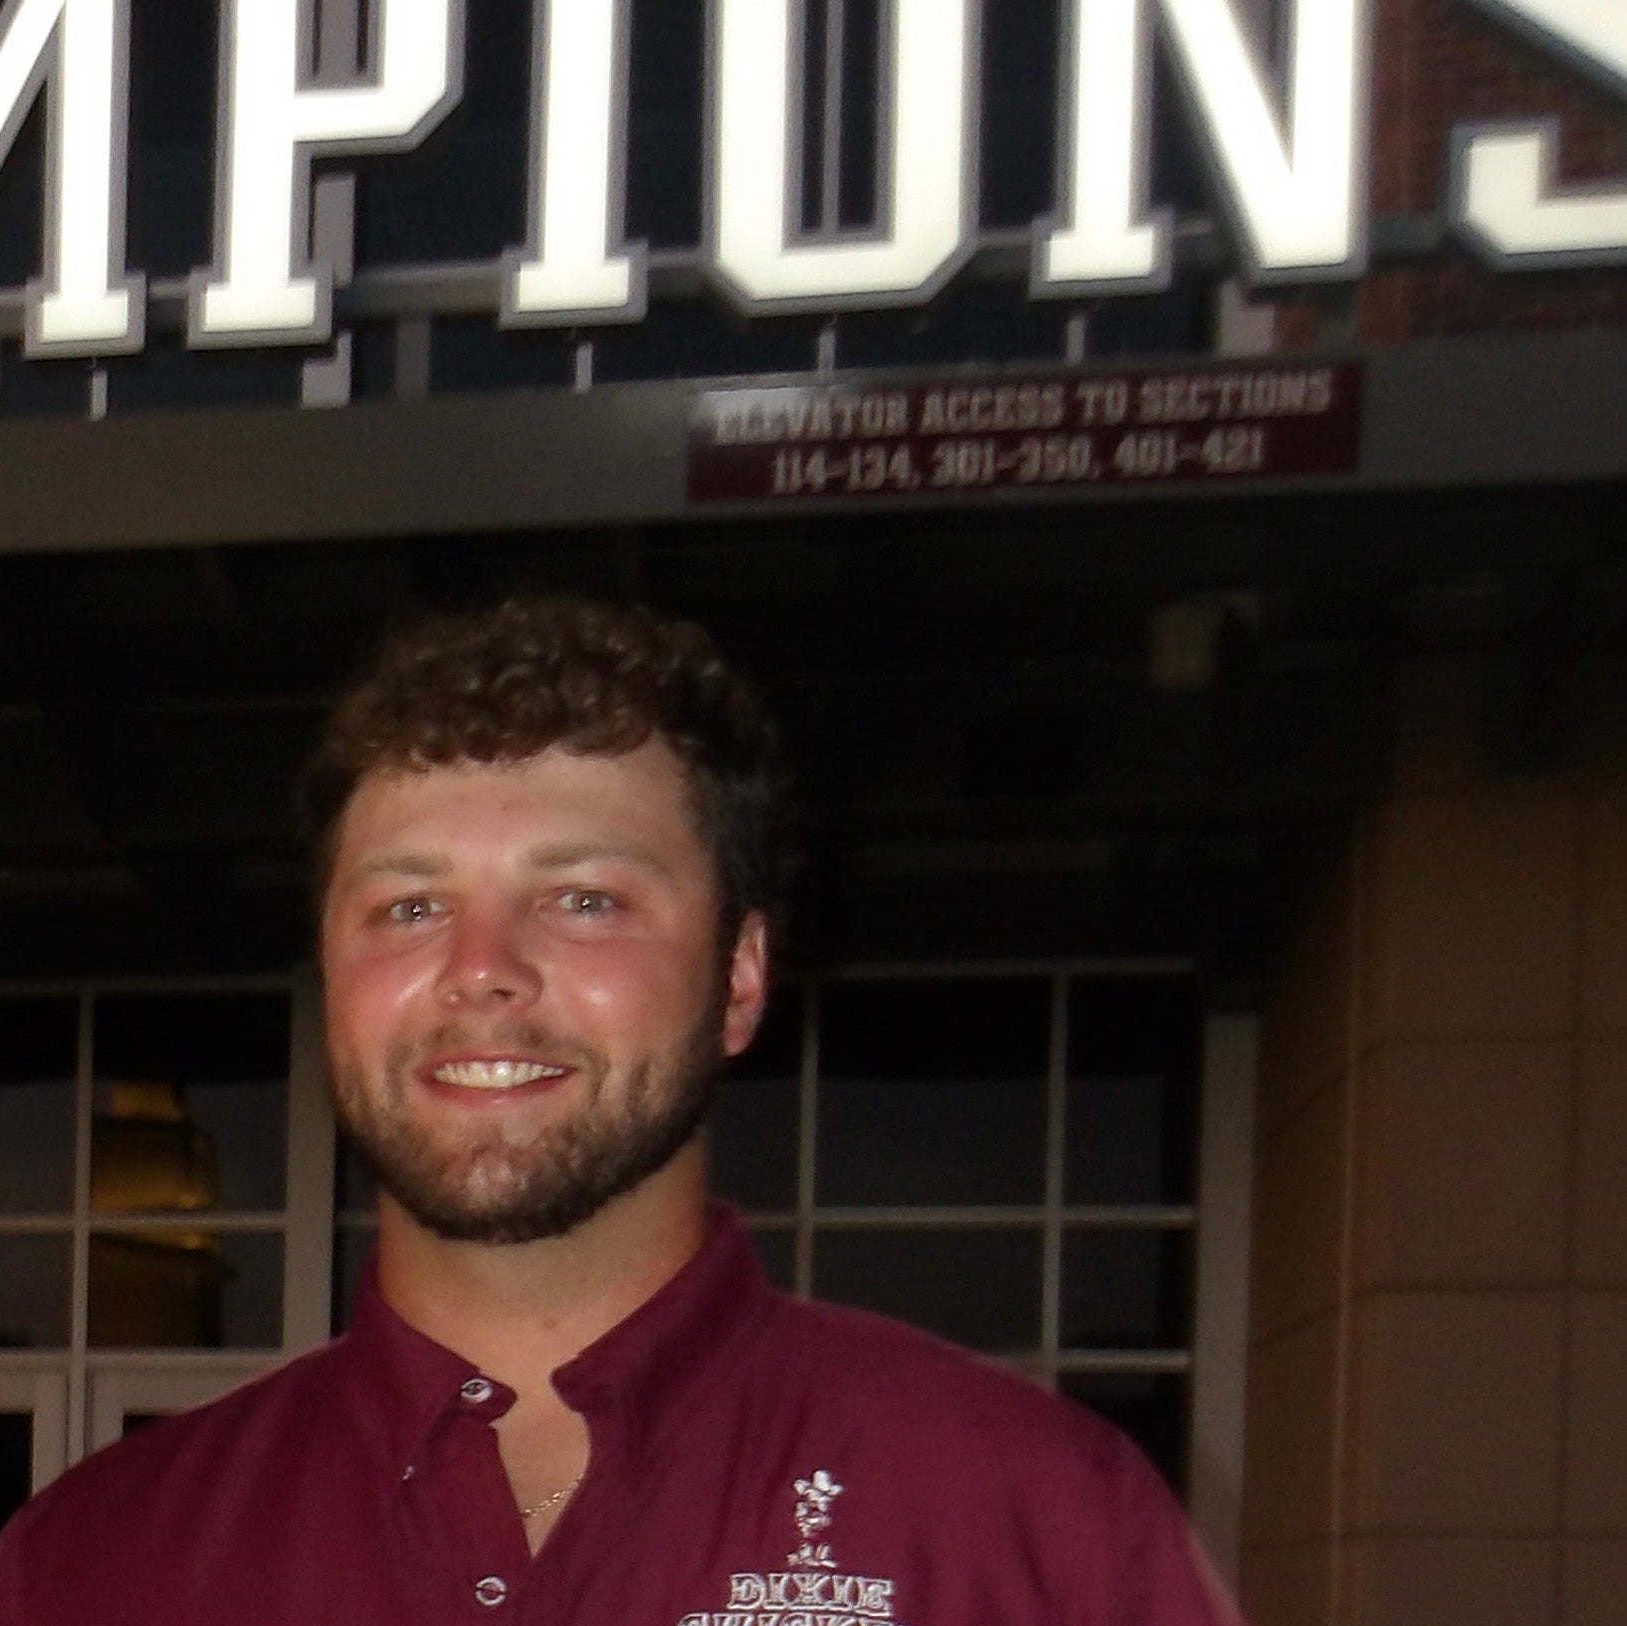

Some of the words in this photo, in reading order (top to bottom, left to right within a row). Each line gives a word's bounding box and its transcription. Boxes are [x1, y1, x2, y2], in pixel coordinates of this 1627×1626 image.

[714, 387, 909, 447] ELEVATOR
[918, 380, 1065, 437] ACCESS
[1076, 377, 1129, 427] TO
[1137, 367, 1333, 424] SECTIONS
[1114, 423, 1265, 479] 401-421
[727, 1573, 894, 1617] DIXIE
